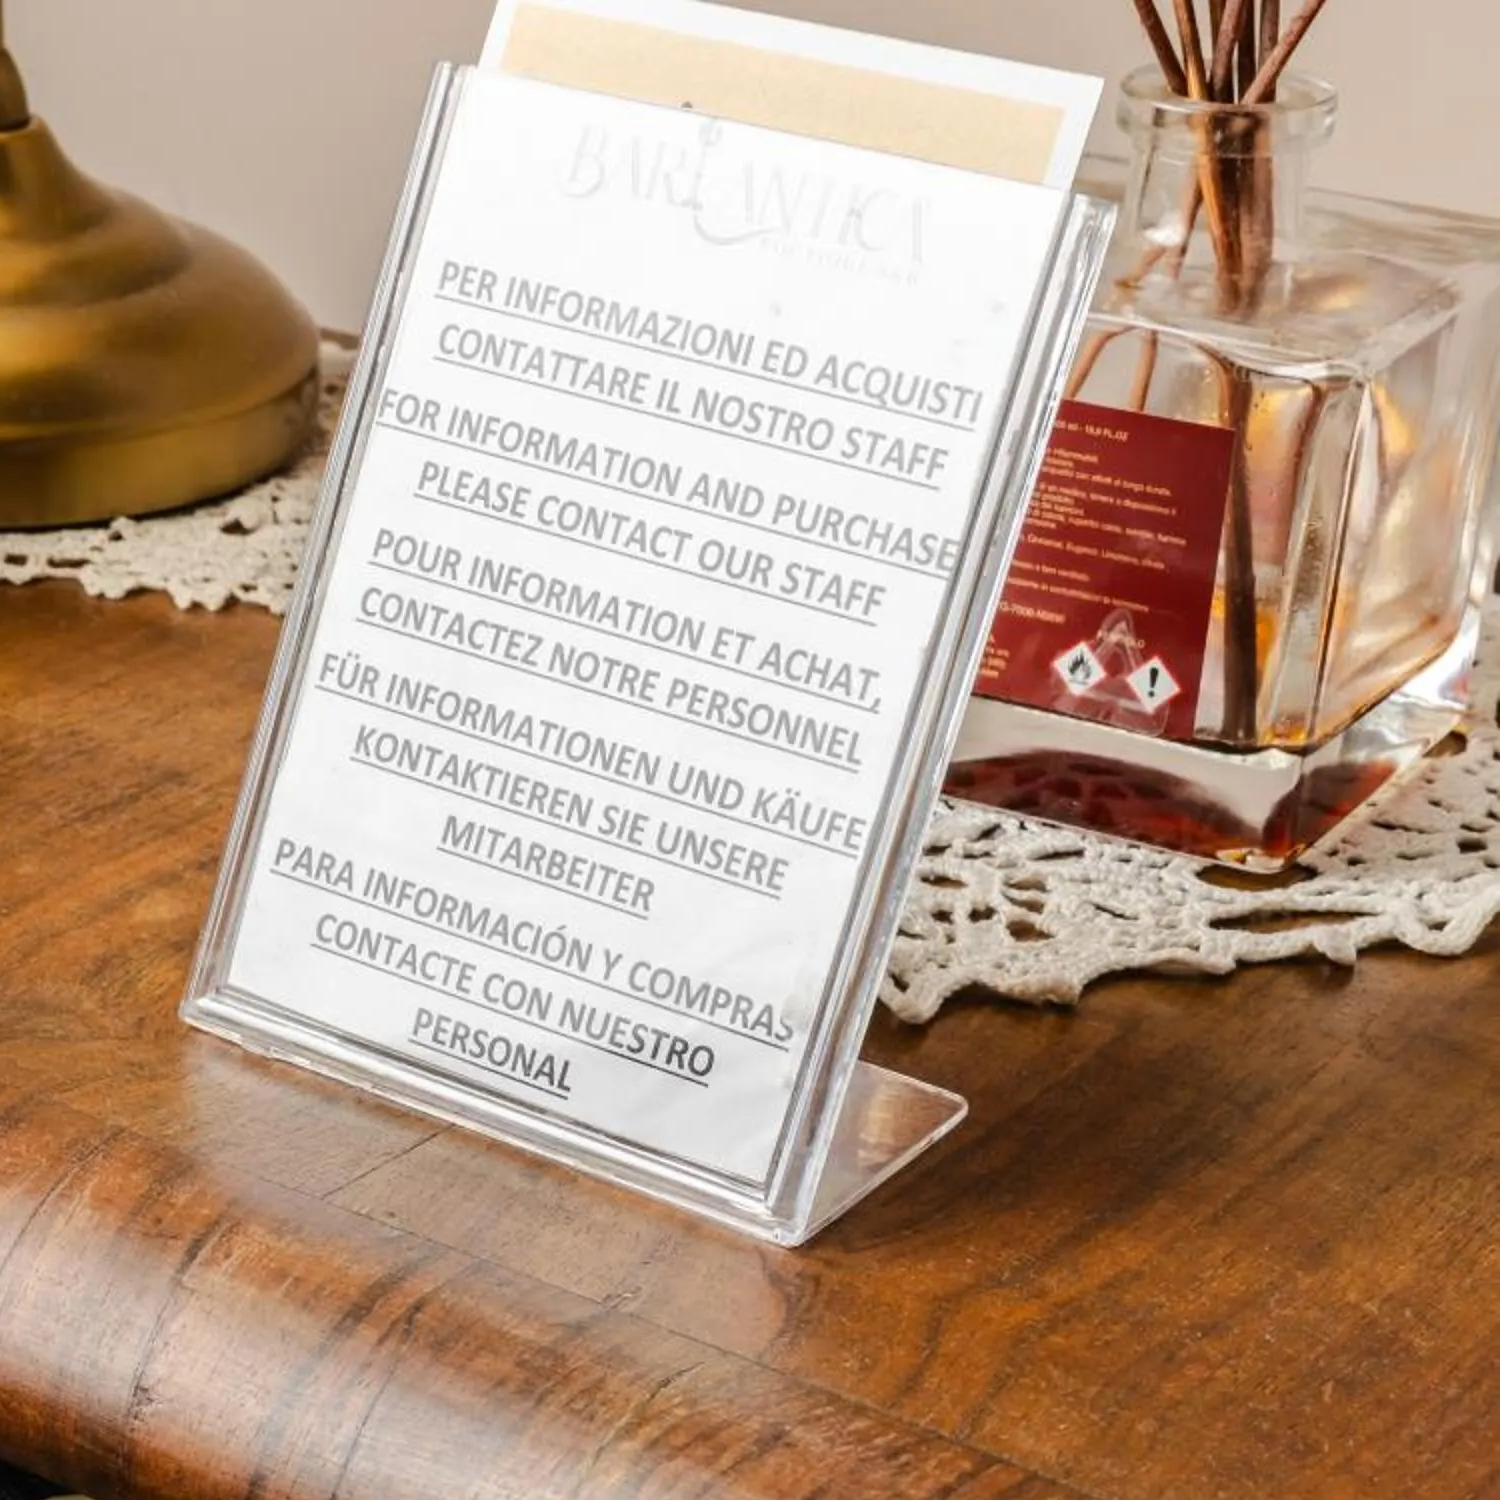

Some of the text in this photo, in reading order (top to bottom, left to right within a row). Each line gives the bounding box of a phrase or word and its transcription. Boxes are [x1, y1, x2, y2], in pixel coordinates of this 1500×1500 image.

[439, 261, 982, 422] PER INFORMAZIONI ED ACQUISTI
[440, 325, 948, 479] CONTATTARE IL NOSTRO STAFF
[379, 389, 440, 431] FOR
[447, 406, 682, 496] INFORMATION
[687, 473, 764, 517] AND
[772, 494, 960, 571] PURCHASE
[418, 461, 886, 615] PLEASE CONTACT OUR STAFF
[361, 587, 861, 765] CONTACTEZ NOTRE PERSONNEL
[373, 528, 882, 711] POUR INFORMATION ET ACHAT,
[320, 651, 866, 850] FÜR INFORMATIONEN UND KÄUFE
[354, 725, 789, 891] KONTAKTIEREN SIE UNSERE
[275, 838, 793, 1041] PARA INFORMACIÓN Y COMPRAS
[442, 815, 654, 912] MITARBEITER
[316, 914, 714, 1076] CONTACTE CON NUESTRO
[413, 1008, 571, 1092] PERSONAL
